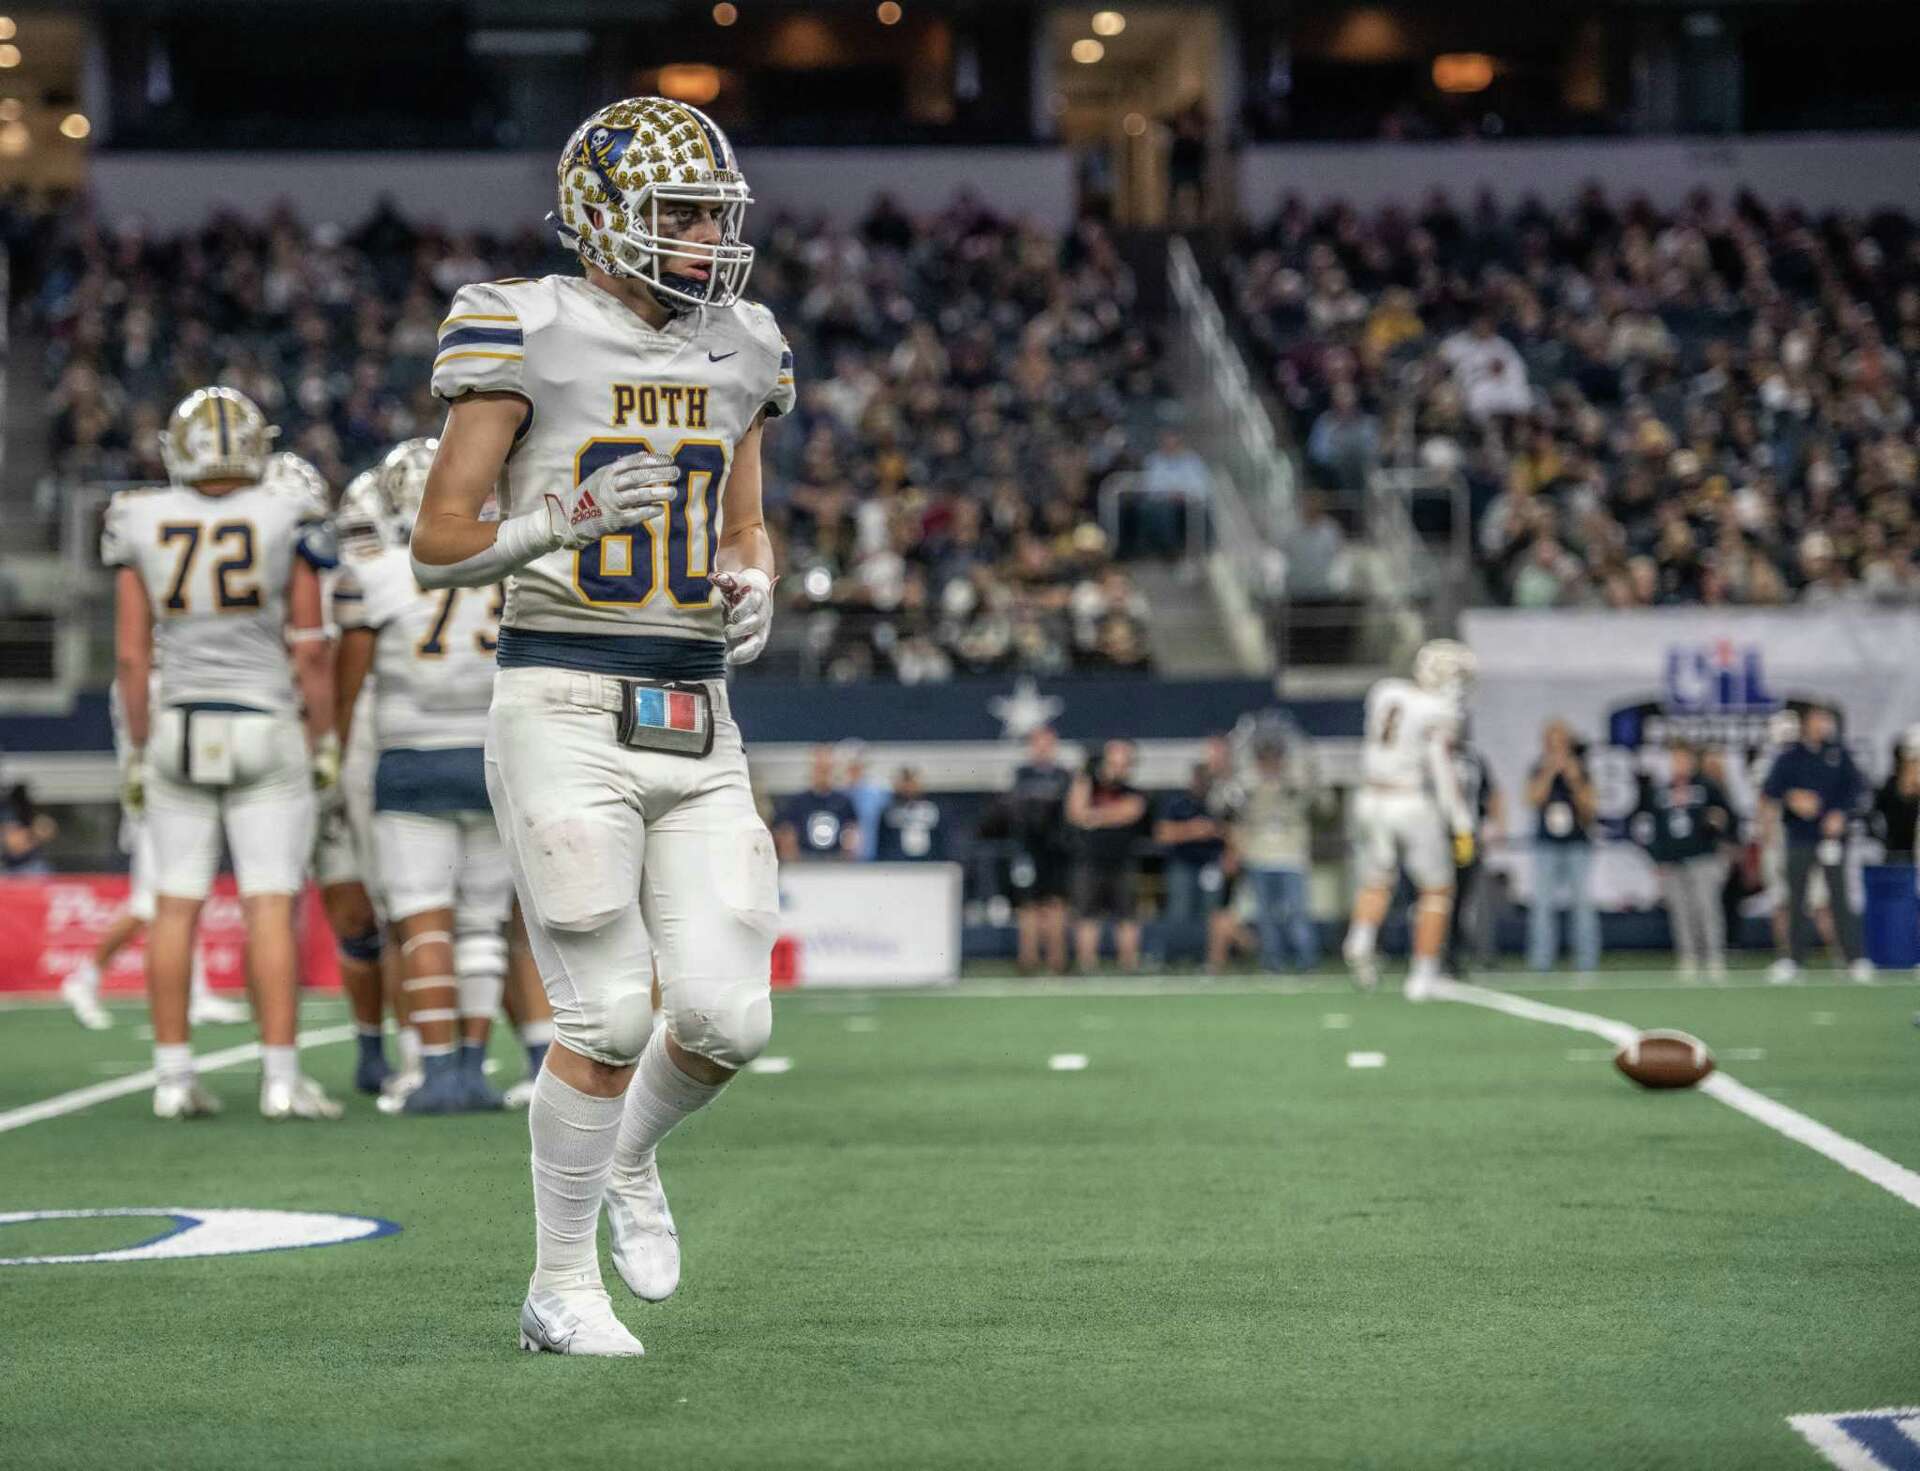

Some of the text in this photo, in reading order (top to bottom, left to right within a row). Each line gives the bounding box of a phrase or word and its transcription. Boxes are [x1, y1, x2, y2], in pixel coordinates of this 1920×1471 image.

[610, 383, 708, 430] POTH
[570, 507, 602, 526] adidas
[158, 519, 262, 613] 72
